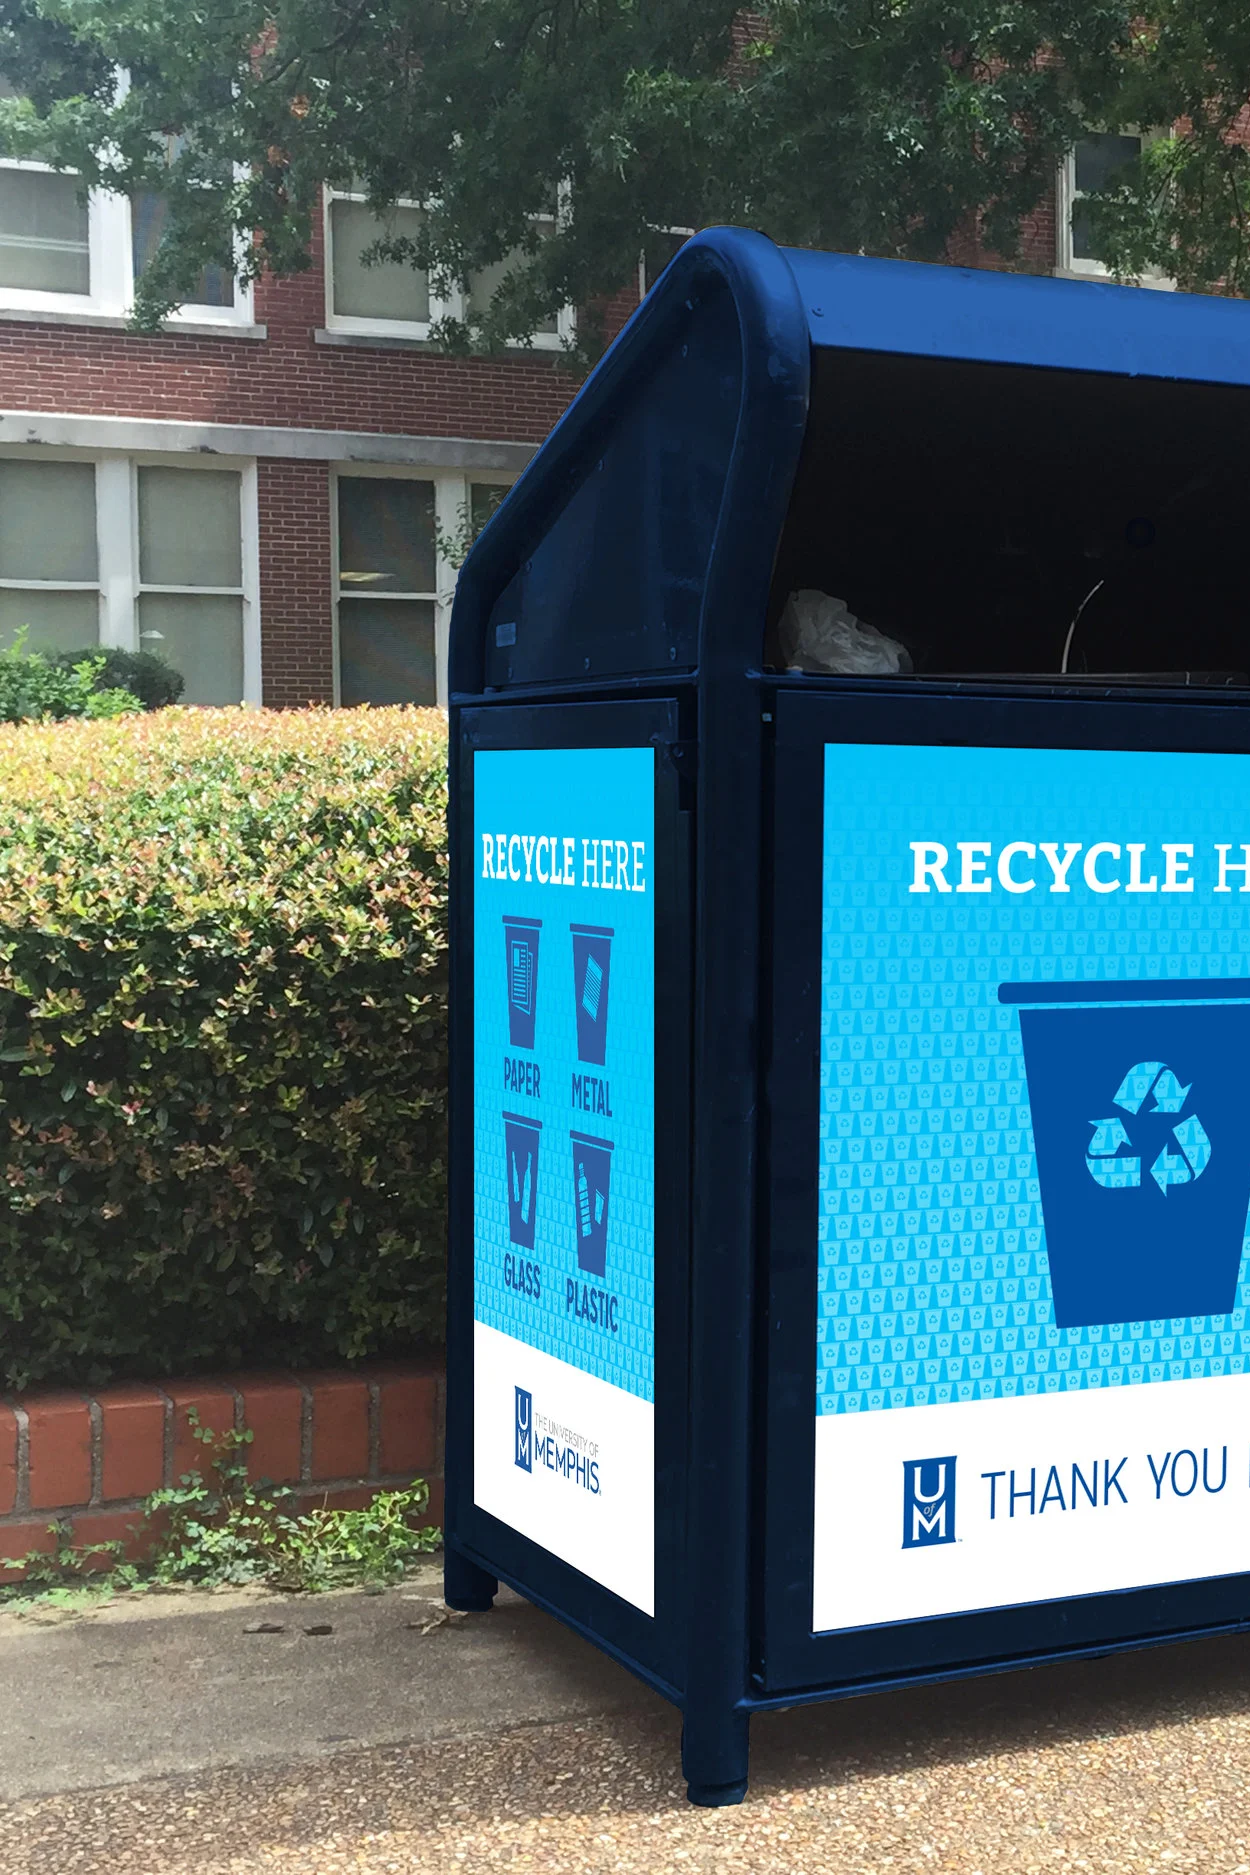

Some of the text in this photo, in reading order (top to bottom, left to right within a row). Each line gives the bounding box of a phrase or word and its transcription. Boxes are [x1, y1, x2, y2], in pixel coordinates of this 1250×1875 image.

[482, 833, 646, 892] RECYCLE HERE
[908, 841, 1195, 893] RECYCLE
[504, 1056, 541, 1099] PAPER
[571, 1072, 613, 1118] METAL
[504, 1252, 541, 1300] GLASS
[566, 1278, 619, 1333] PLASTIC
[534, 1412, 548, 1432] THE
[548, 1419, 588, 1453] UNIVERSITY
[588, 1441, 599, 1458] OF
[534, 1430, 600, 1495] MEMPHIS
[981, 1457, 1129, 1520] THANK
[1146, 1445, 1228, 1500] YOU
[923, 1503, 937, 1518] of
